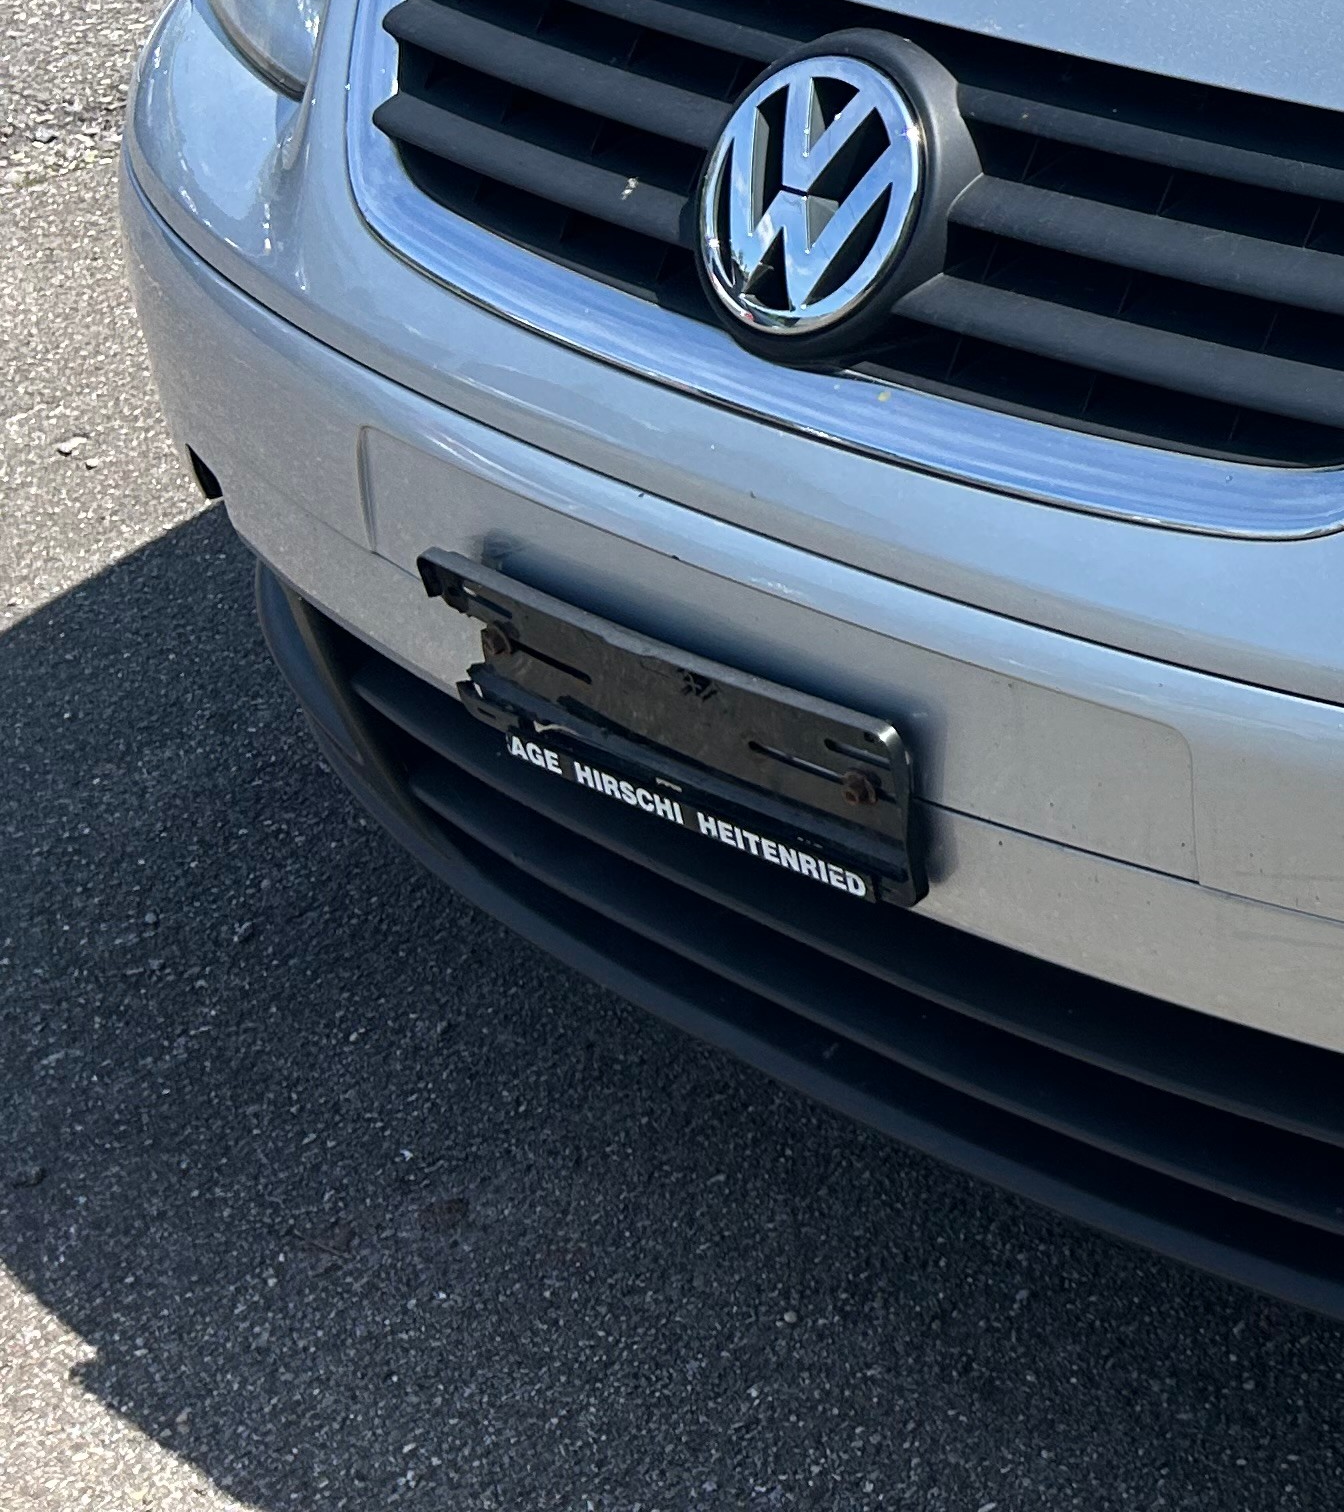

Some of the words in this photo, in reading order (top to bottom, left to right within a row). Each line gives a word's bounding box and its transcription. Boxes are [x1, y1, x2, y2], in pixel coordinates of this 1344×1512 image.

[703, 56, 916, 333] VW
[506, 734, 562, 775] AGE
[573, 761, 685, 825] HIRSCHI
[696, 811, 867, 898] HEITENRIED
